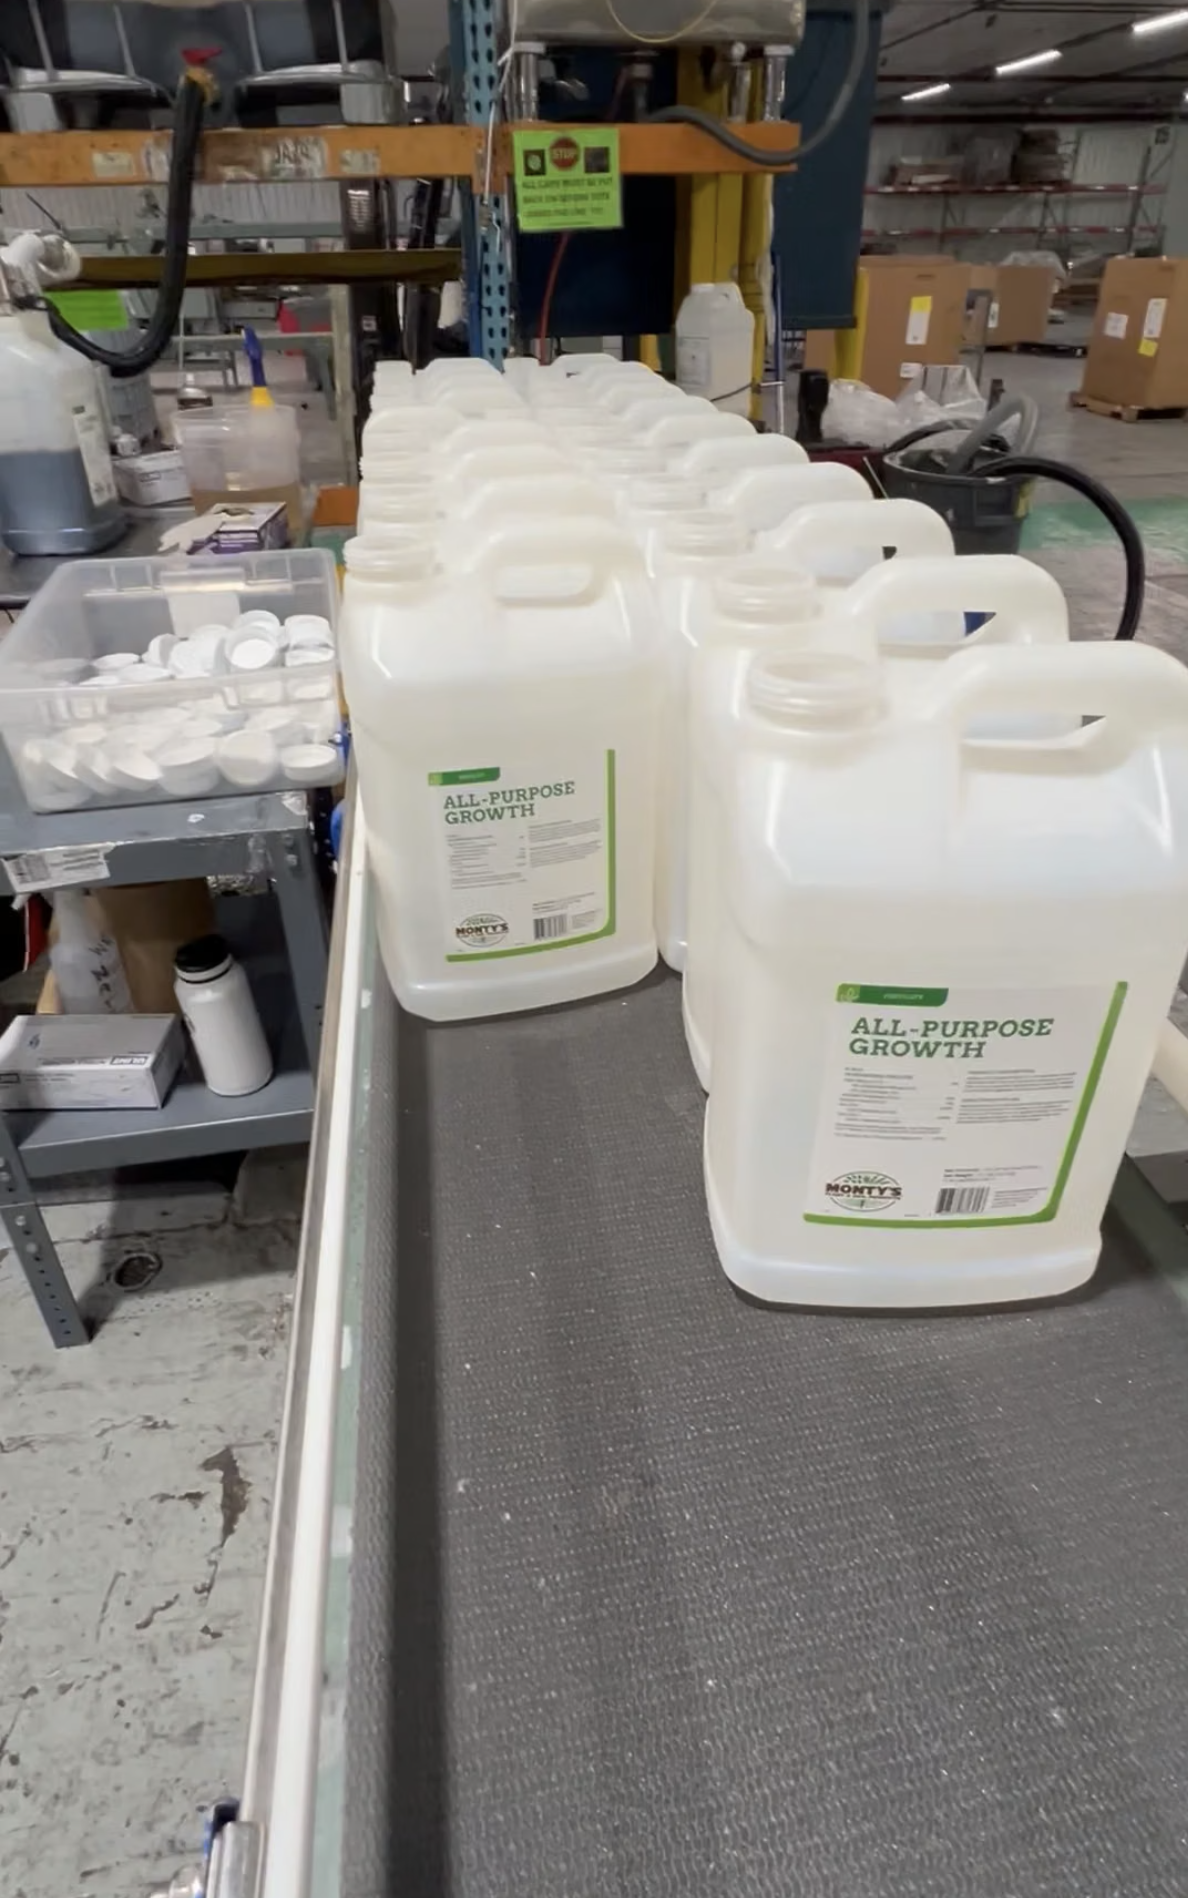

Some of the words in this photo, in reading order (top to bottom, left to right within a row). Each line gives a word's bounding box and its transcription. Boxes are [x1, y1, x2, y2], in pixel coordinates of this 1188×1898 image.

[552, 148, 576, 160] STOP
[443, 781, 575, 809] ALL-PURPOSE
[445, 803, 535, 825] GROWTH
[455, 922, 509, 937] MONTY'S
[851, 1017, 1054, 1038] ALL-PURPOSE
[849, 1038, 986, 1058] GROWTH
[825, 1183, 902, 1197] MONTY'S
